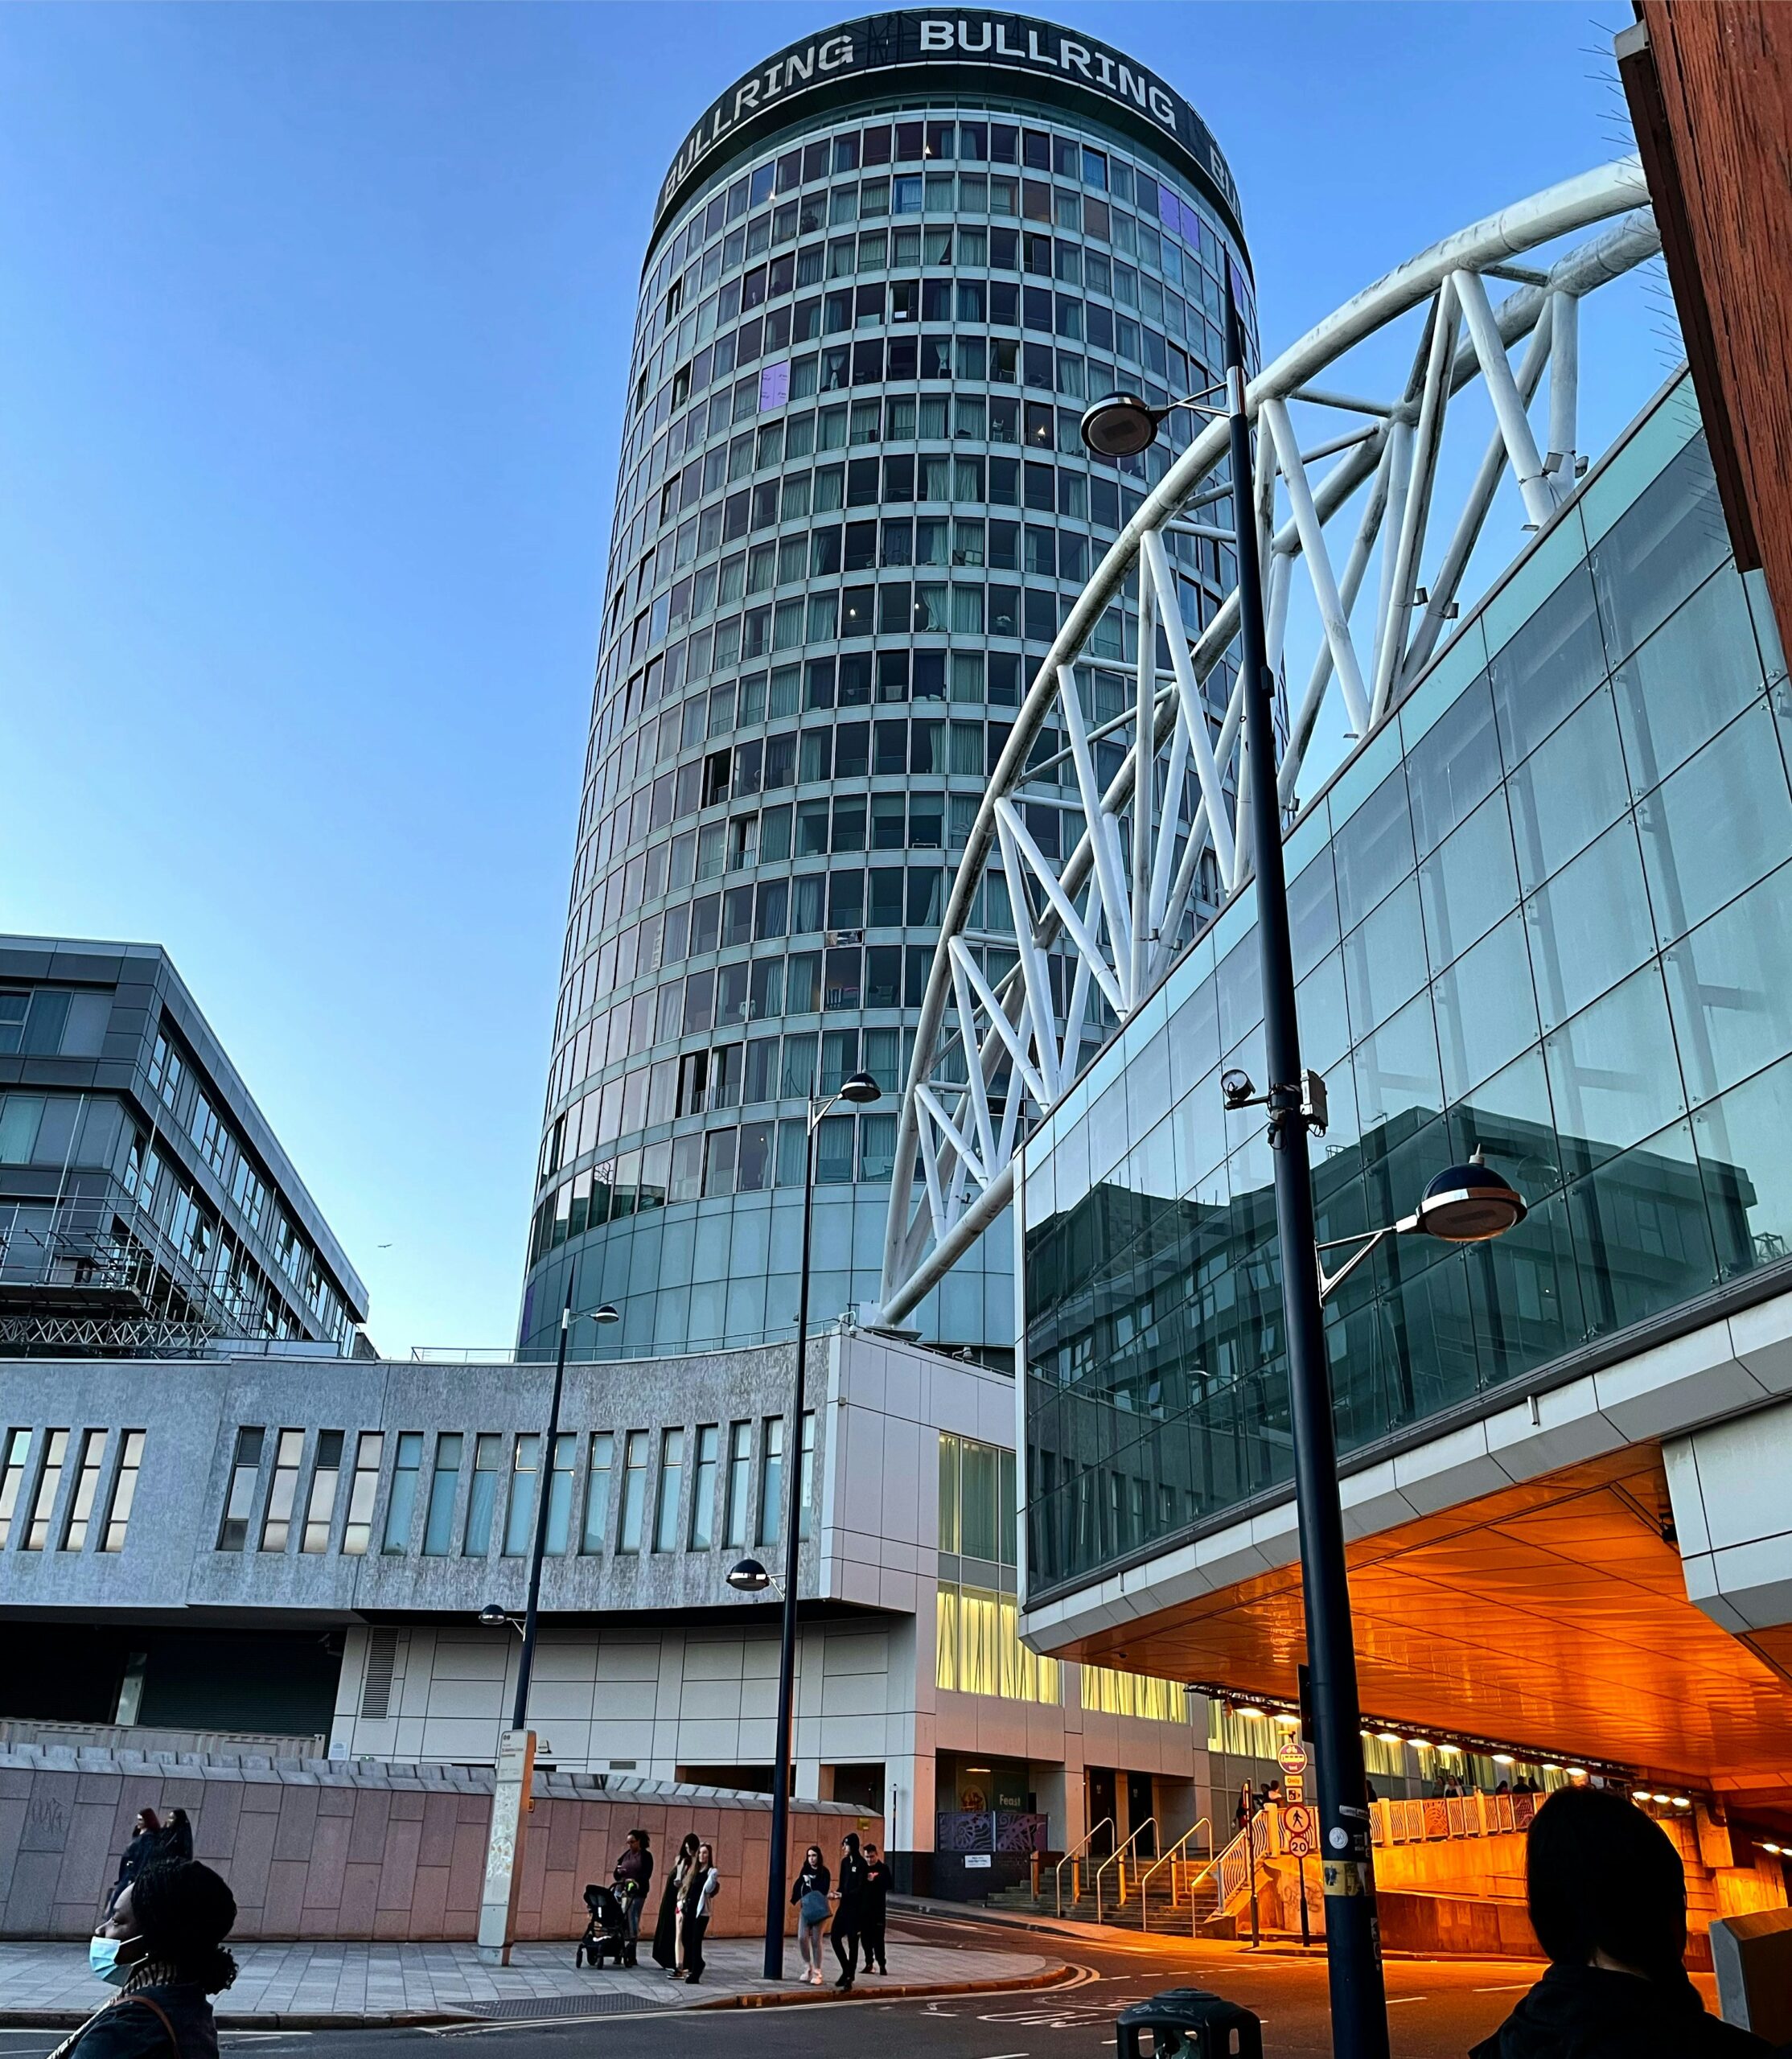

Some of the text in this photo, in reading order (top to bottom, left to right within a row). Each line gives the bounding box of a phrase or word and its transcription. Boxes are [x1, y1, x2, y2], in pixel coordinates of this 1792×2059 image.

[919, 20, 1177, 131] BULLRING
[664, 35, 853, 207] BULLRING
[999, 1794, 1021, 1806] Feast
[1292, 1842, 1307, 1852] 20
